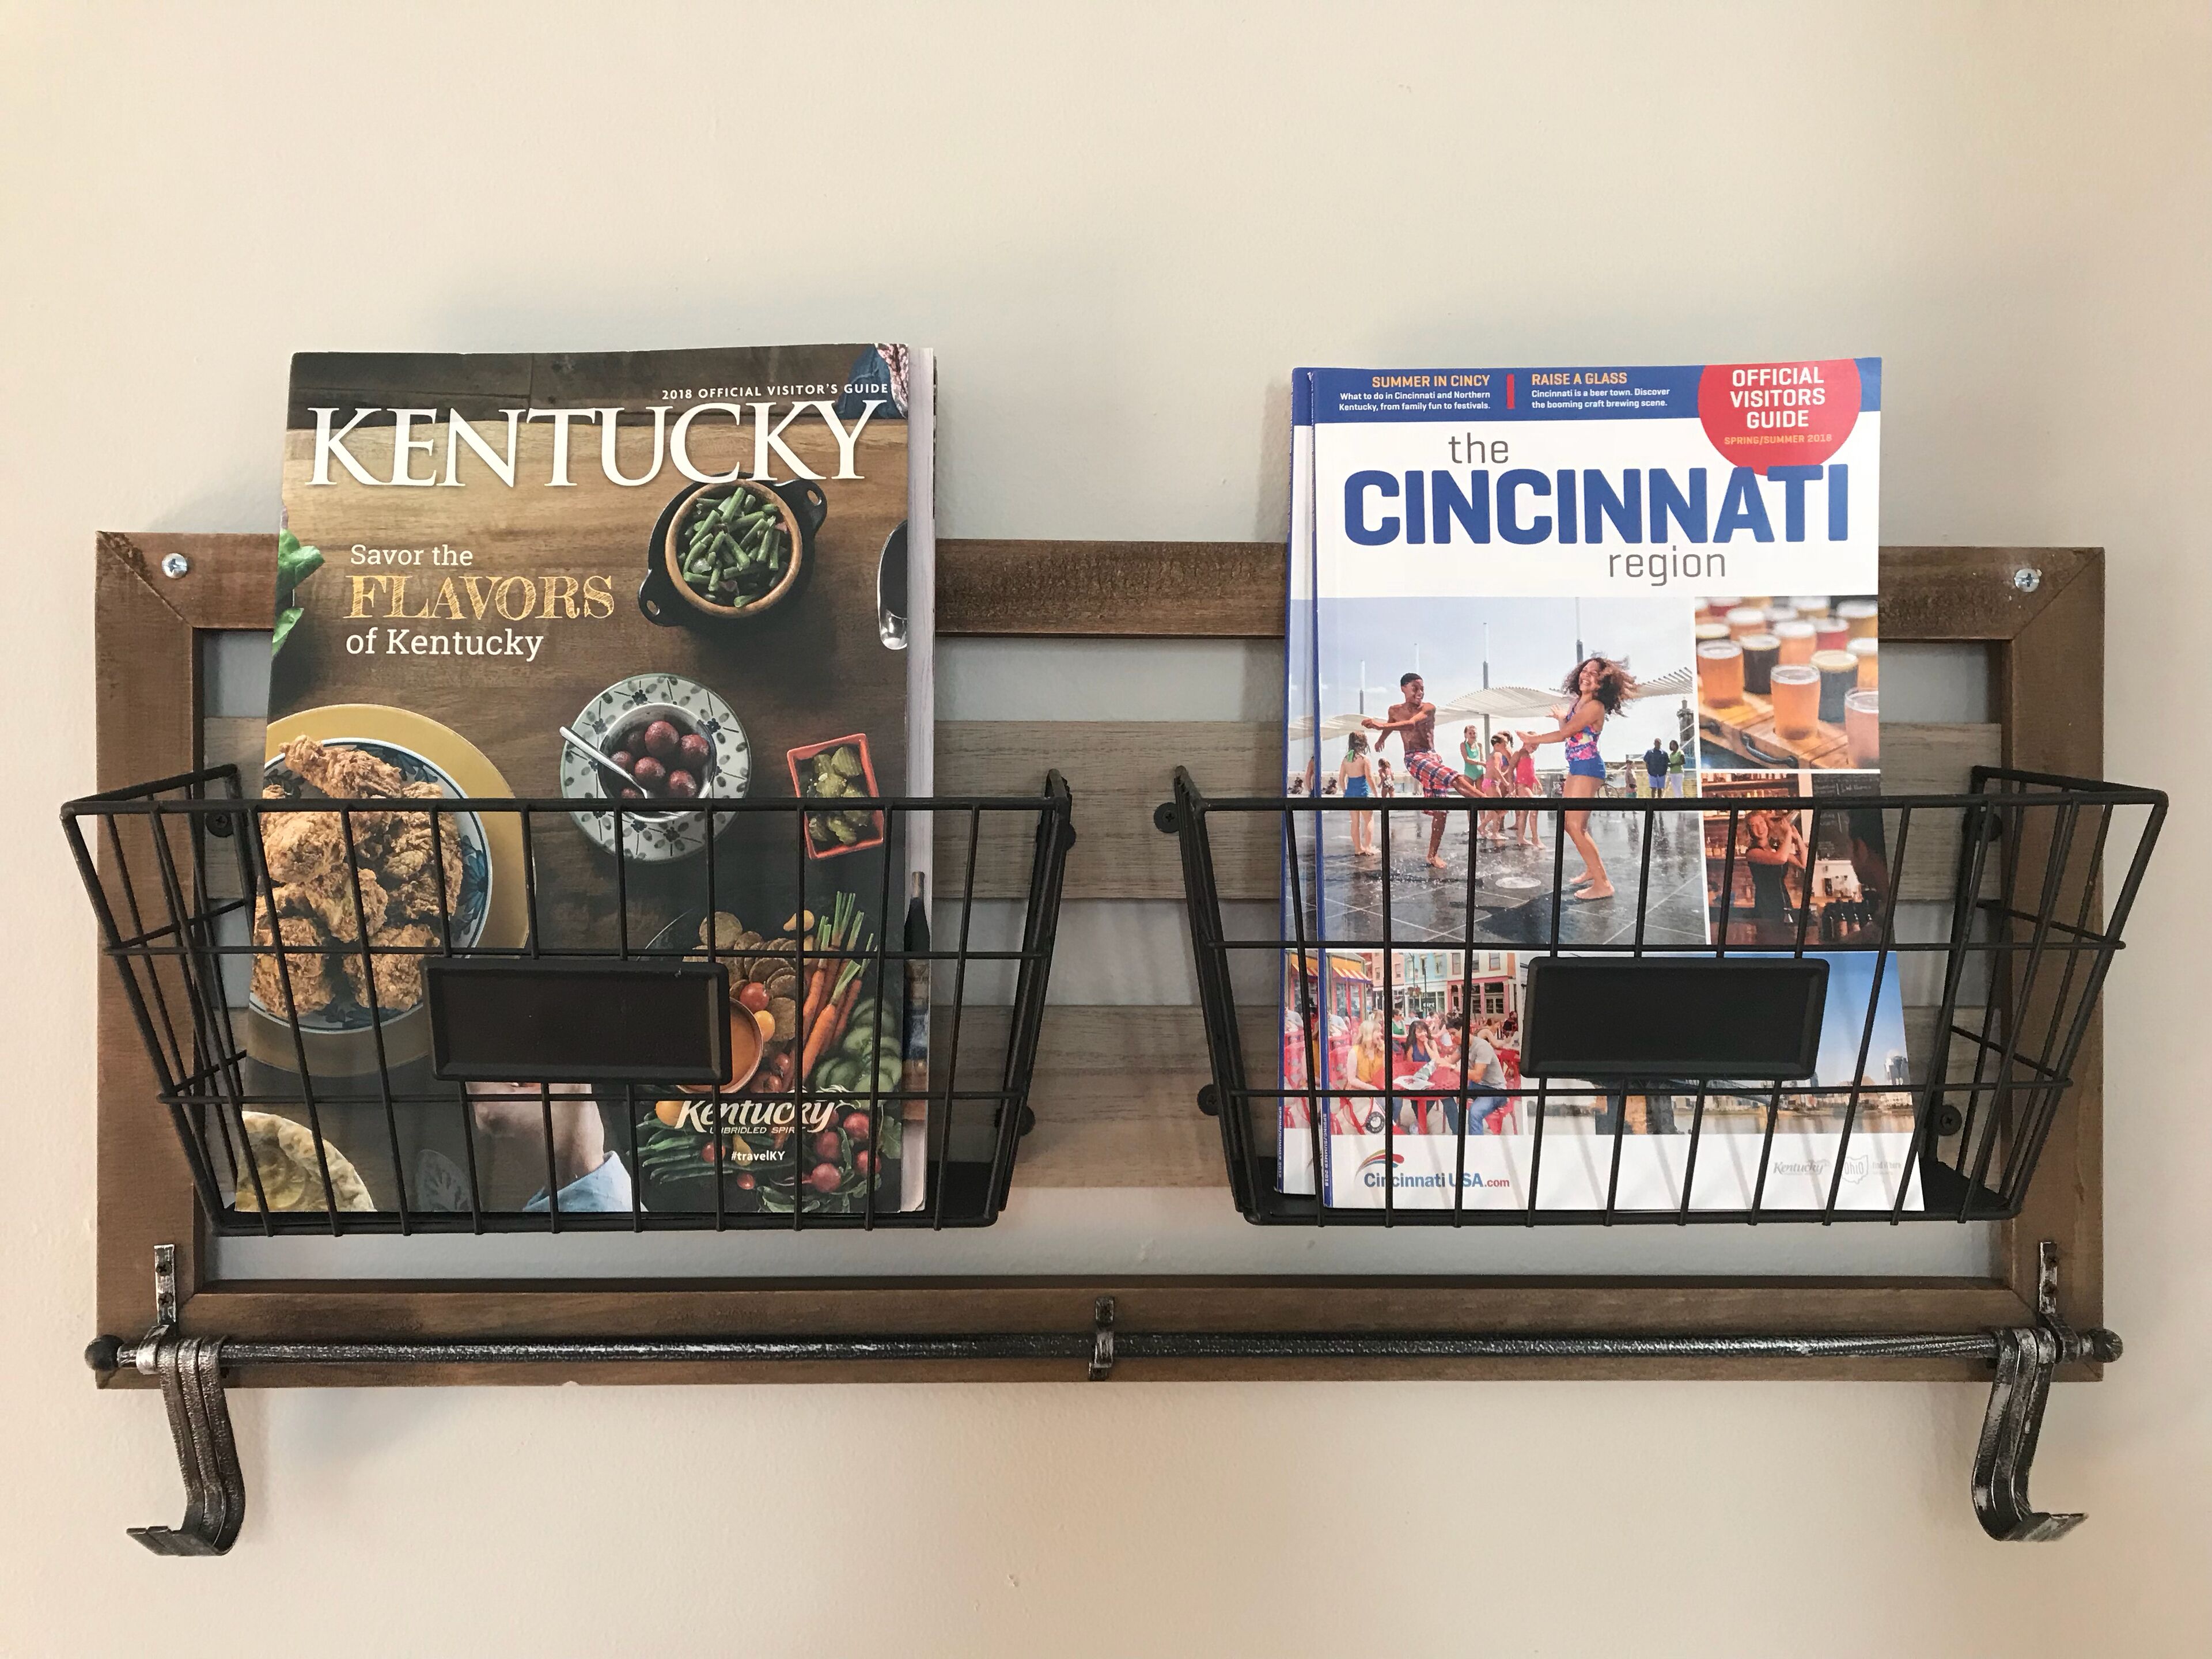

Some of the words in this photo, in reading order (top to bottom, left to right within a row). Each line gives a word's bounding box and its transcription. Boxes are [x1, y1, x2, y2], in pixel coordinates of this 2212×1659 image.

[1372, 376, 1430, 388] SUMMER
[1434, 375, 1447, 387] IN
[1450, 374, 1490, 387] CINCY
[1531, 373, 1570, 385] RAISE
[1573, 373, 1582, 385] A
[1585, 372, 1627, 384] GLASS
[1732, 366, 1824, 387] OFFICIAL
[662, 389, 692, 400] 2018
[698, 385, 762, 399] OFFICIAL
[843, 383, 888, 395] GUIDE
[1340, 392, 1362, 400] What
[1395, 391, 1436, 399] Cincinnati
[1454, 391, 1491, 399] Northern
[1532, 389, 1573, 397] Cincinnati
[1729, 388, 1825, 408] VISITORS
[1339, 403, 1379, 412] Kentucky,
[1402, 402, 1427, 412] family
[1453, 402, 1491, 410] festivals.
[1547, 400, 1583, 410] booming
[1584, 400, 1604, 408] craft
[1606, 399, 1639, 408] brewing
[1746, 410, 1809, 429] GUIDE
[305, 400, 888, 488] KENTUCKY
[1724, 434, 1805, 445] SPRING/SUMMER
[1807, 433, 1832, 442] 2018
[1448, 432, 1509, 464] the
[1343, 463, 1849, 546] CINCINNATI
[350, 544, 424, 566] Savor
[432, 544, 474, 566] the
[1609, 545, 1726, 587] region
[343, 575, 615, 621] FLAVORS
[346, 627, 378, 655] of
[385, 628, 544, 662] Kentucky
[771, 1126, 806, 1134] SPIR
[731, 1150, 786, 1161] #travelKY
[1773, 1160, 1824, 1175] Kentucky
